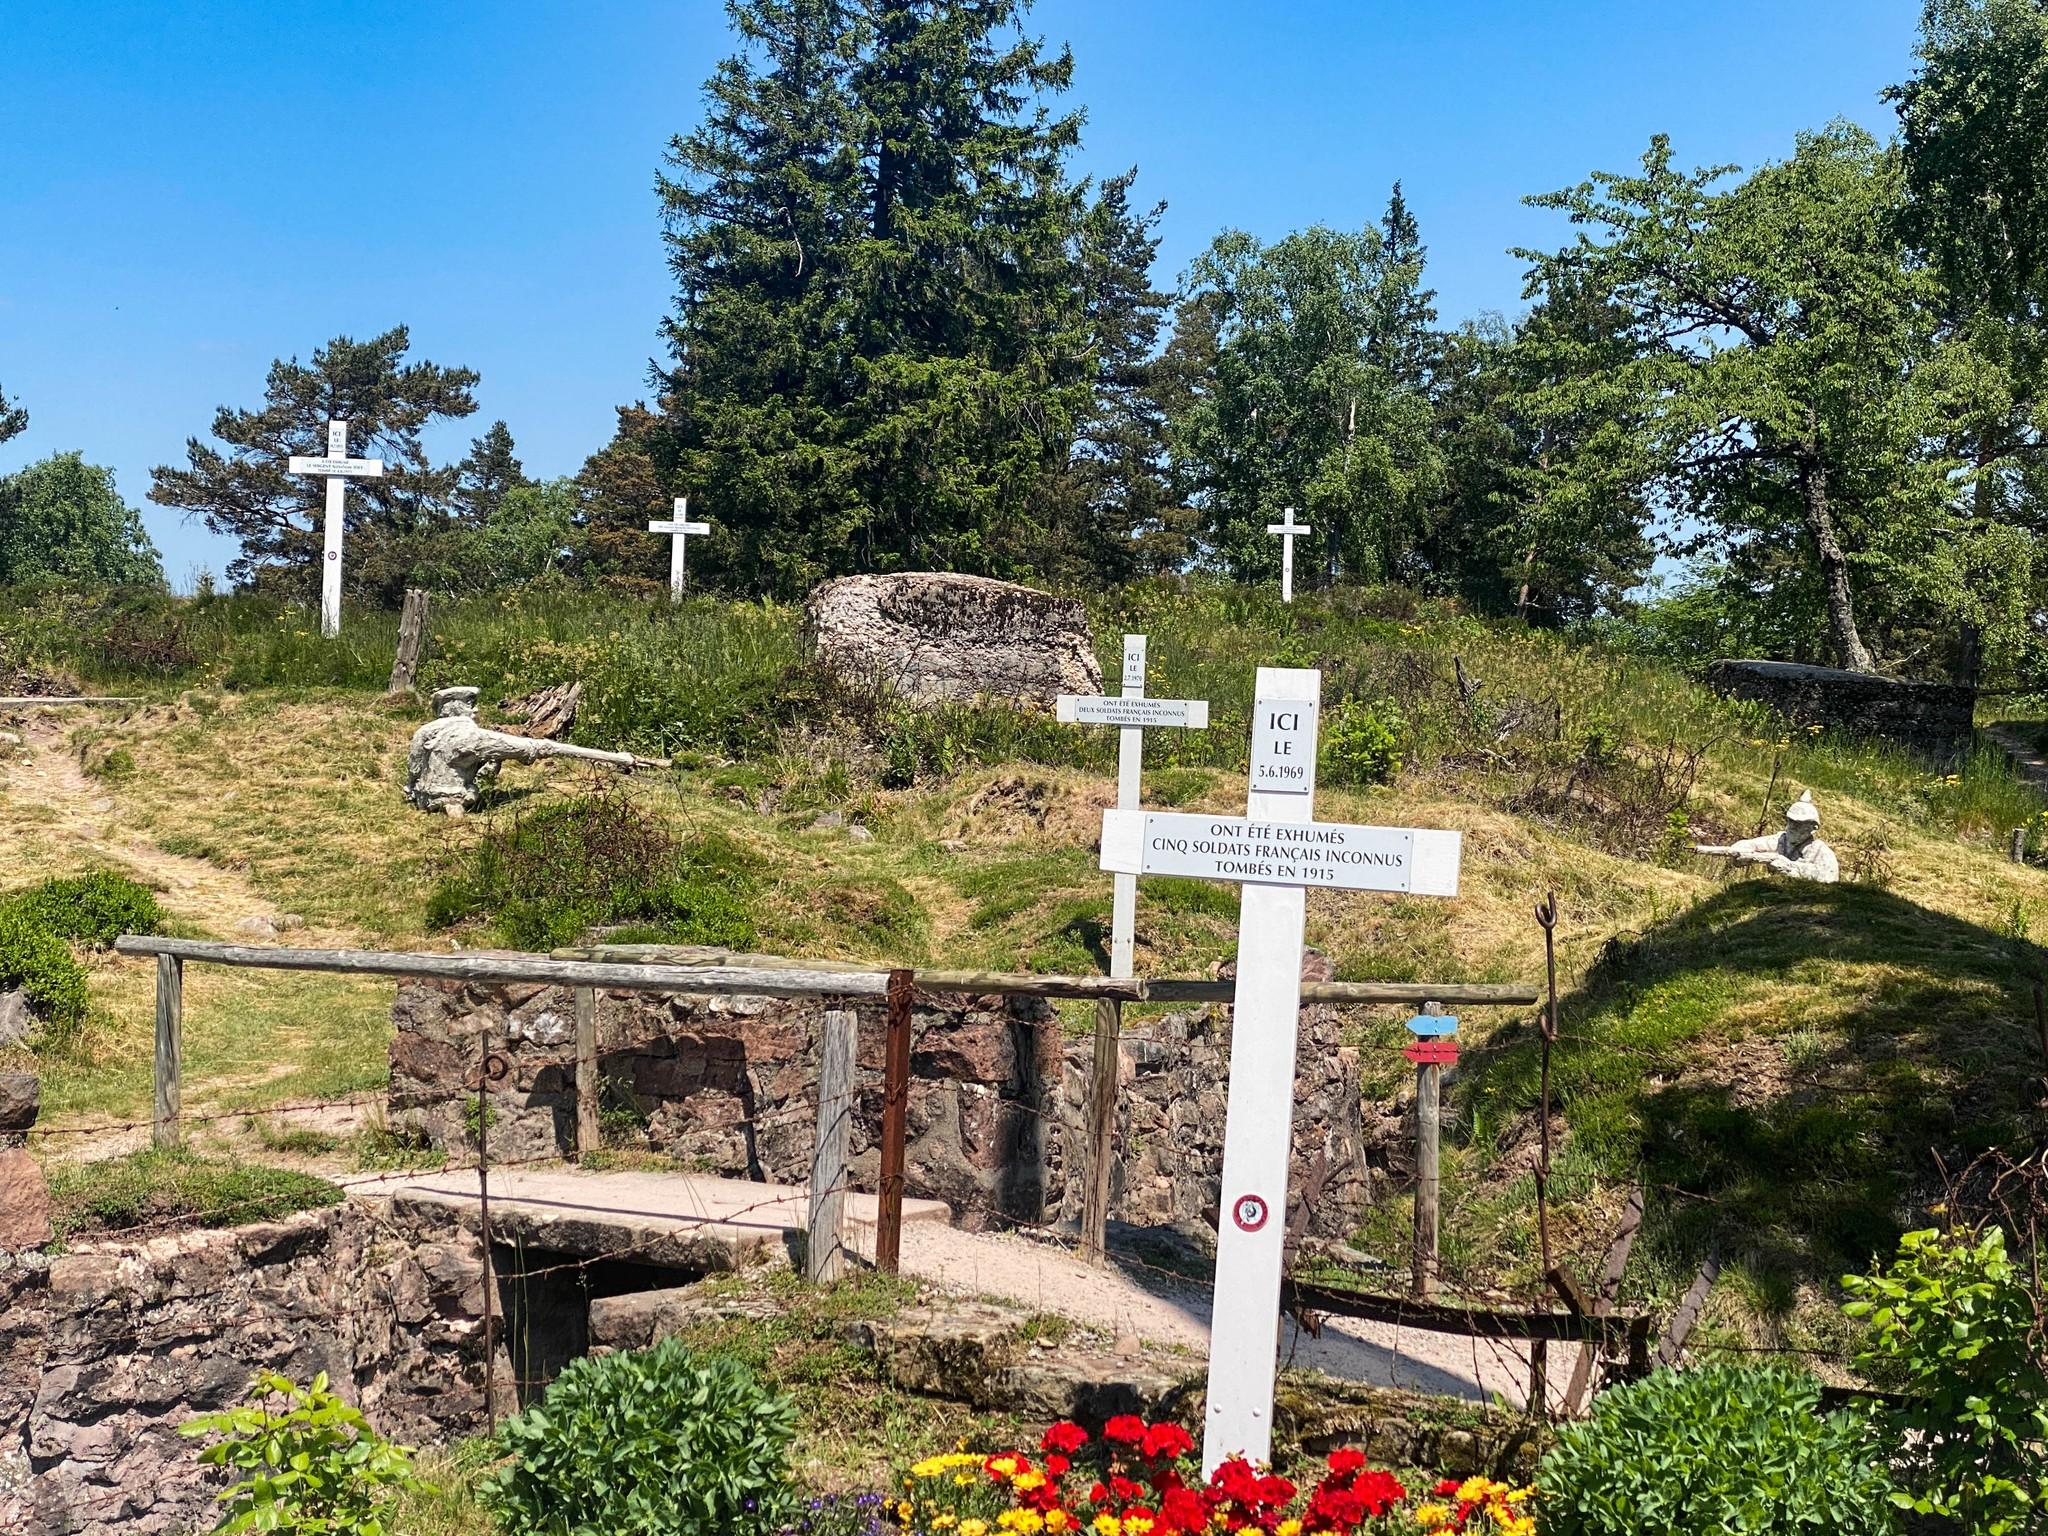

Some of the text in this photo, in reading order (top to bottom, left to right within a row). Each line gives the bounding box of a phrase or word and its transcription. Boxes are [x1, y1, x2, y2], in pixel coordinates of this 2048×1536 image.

[1128, 653, 1139, 661] ICI
[1119, 699, 1130, 707] ÉTÉ
[1131, 700, 1161, 708] EXHUMÉS
[1106, 714, 1131, 722] TOMBÉS
[1270, 713, 1299, 730] ICI
[1274, 741, 1292, 755] LE
[1259, 765, 1304, 779] 5.6.1969
[1210, 823, 1345, 845] ONT ÉTÉ EXHUMÉS
[1152, 838, 1402, 867] CINQ SOLDATS FRANÇAIS INCONNUS
[1215, 860, 1335, 881] TOMBÉS EN 1915
